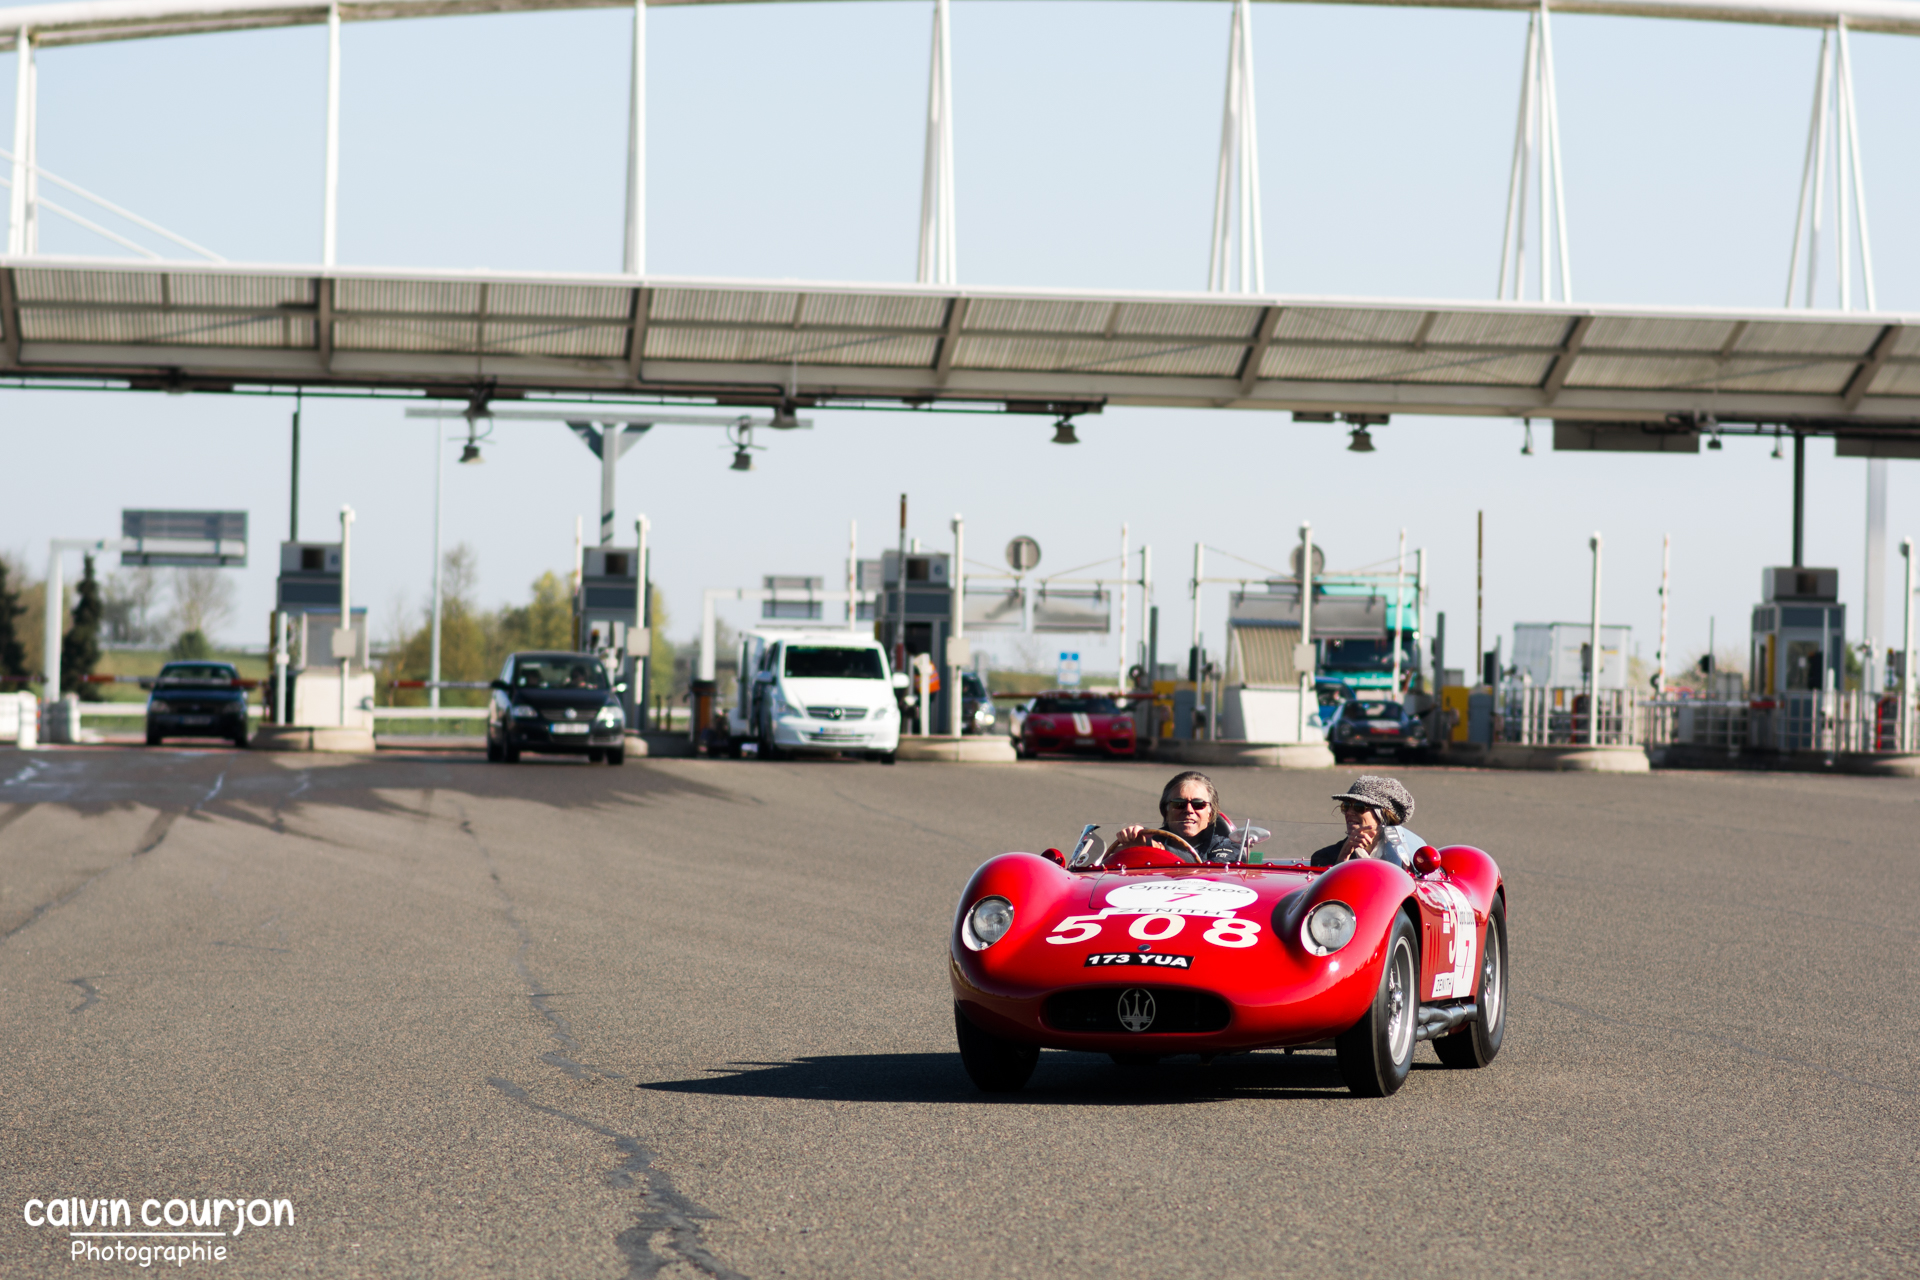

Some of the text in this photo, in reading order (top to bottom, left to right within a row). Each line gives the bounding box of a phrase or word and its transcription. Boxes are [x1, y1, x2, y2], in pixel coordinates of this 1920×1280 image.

[1197, 886, 1251, 894] 2000
[1165, 892, 1202, 903] 7
[1117, 907, 1221, 916] ZENITH
[1045, 914, 1262, 948] 508
[1088, 954, 1188, 968] 173 YUA
